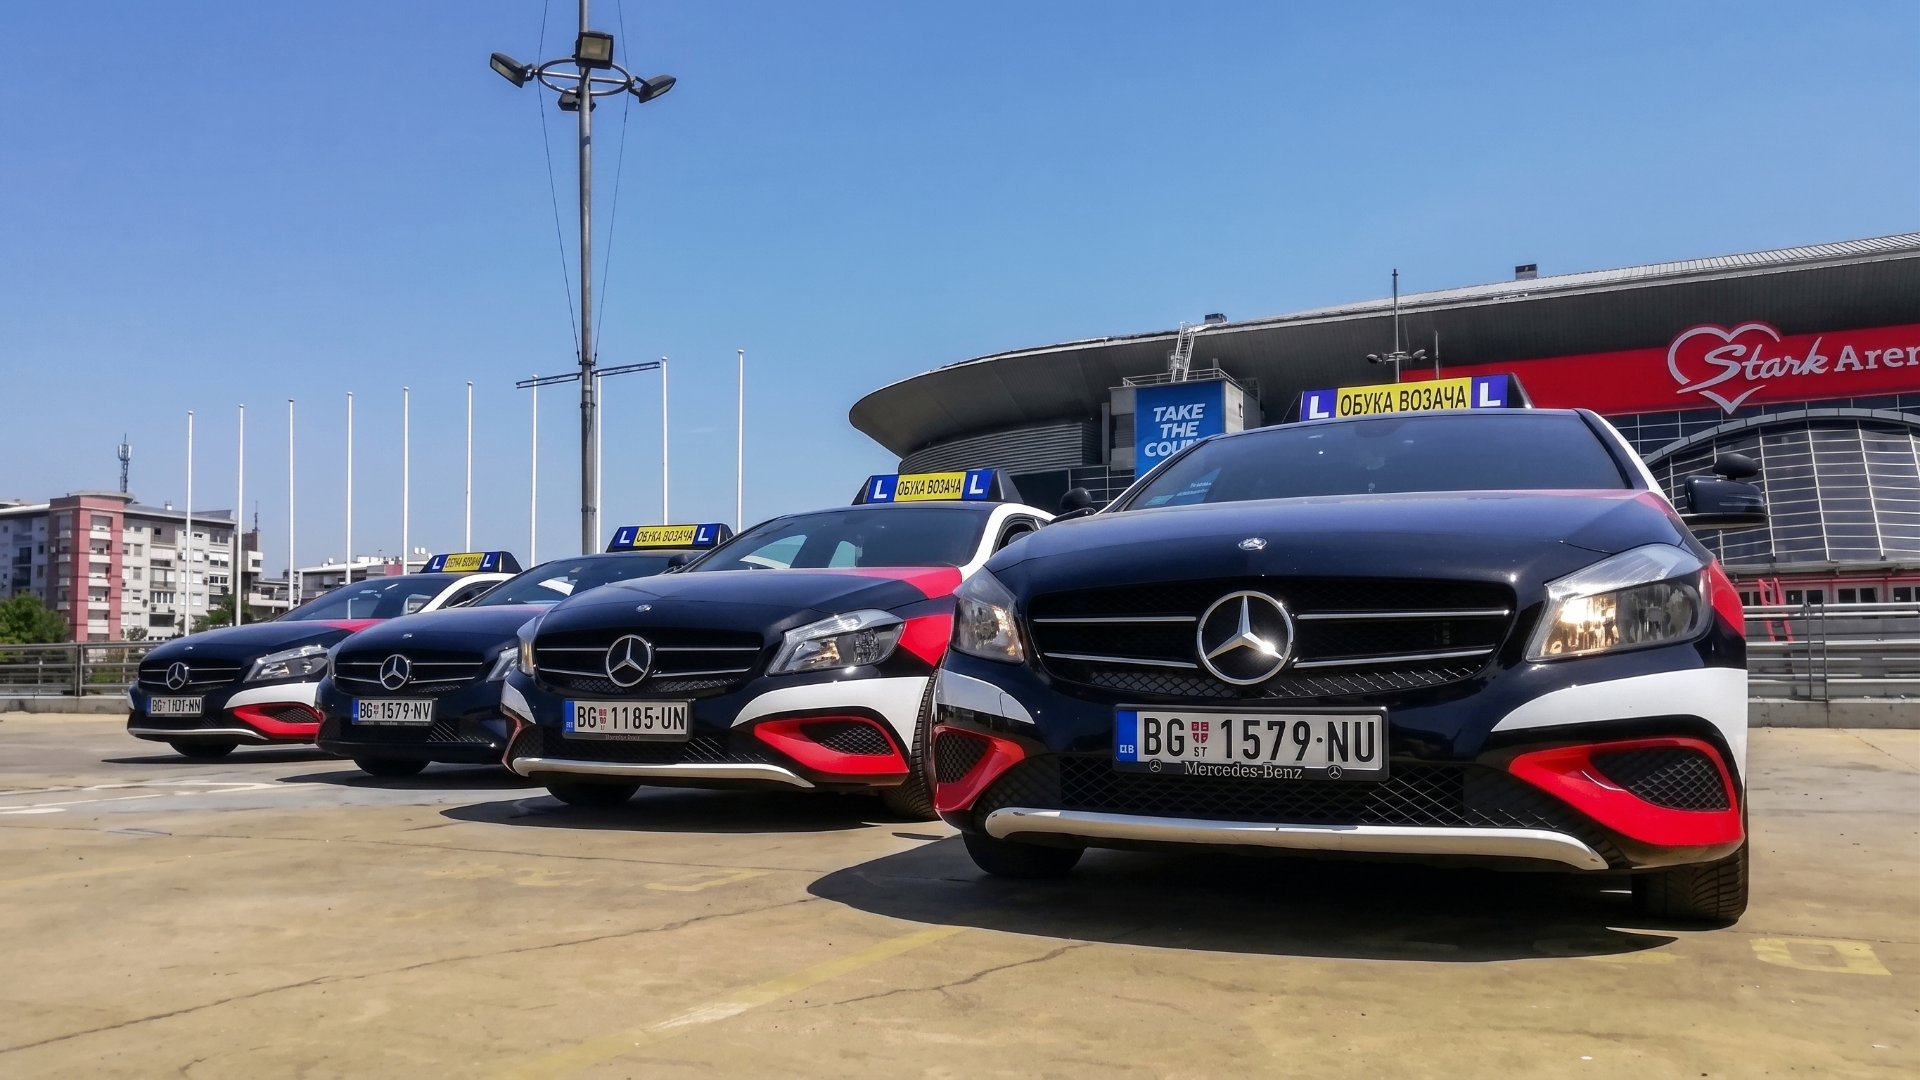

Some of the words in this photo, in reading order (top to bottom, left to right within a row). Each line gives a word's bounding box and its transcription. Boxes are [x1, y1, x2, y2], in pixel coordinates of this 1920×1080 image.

[1677, 337, 1828, 394] Stark
[1340, 392, 1393, 416] ОБУКА
[1400, 386, 1467, 412] ВОЗАЧА
[1479, 382, 1501, 408] L
[1153, 403, 1206, 423] TAKE
[1309, 396, 1330, 419] L
[1160, 420, 1200, 439] THE
[1144, 438, 1201, 457] COU
[873, 479, 888, 499] L
[897, 479, 925, 496] ОБУКА
[927, 478, 962, 495] ВОЗАЧА
[969, 475, 984, 495] L
[619, 530, 631, 544] L
[697, 527, 710, 542] L
[360, 702, 373, 719] BG
[577, 706, 597, 728] BG
[1143, 717, 1186, 757] BG
[1194, 746, 1208, 758] ST
[1184, 761, 1303, 780] Mercedes-Benz
